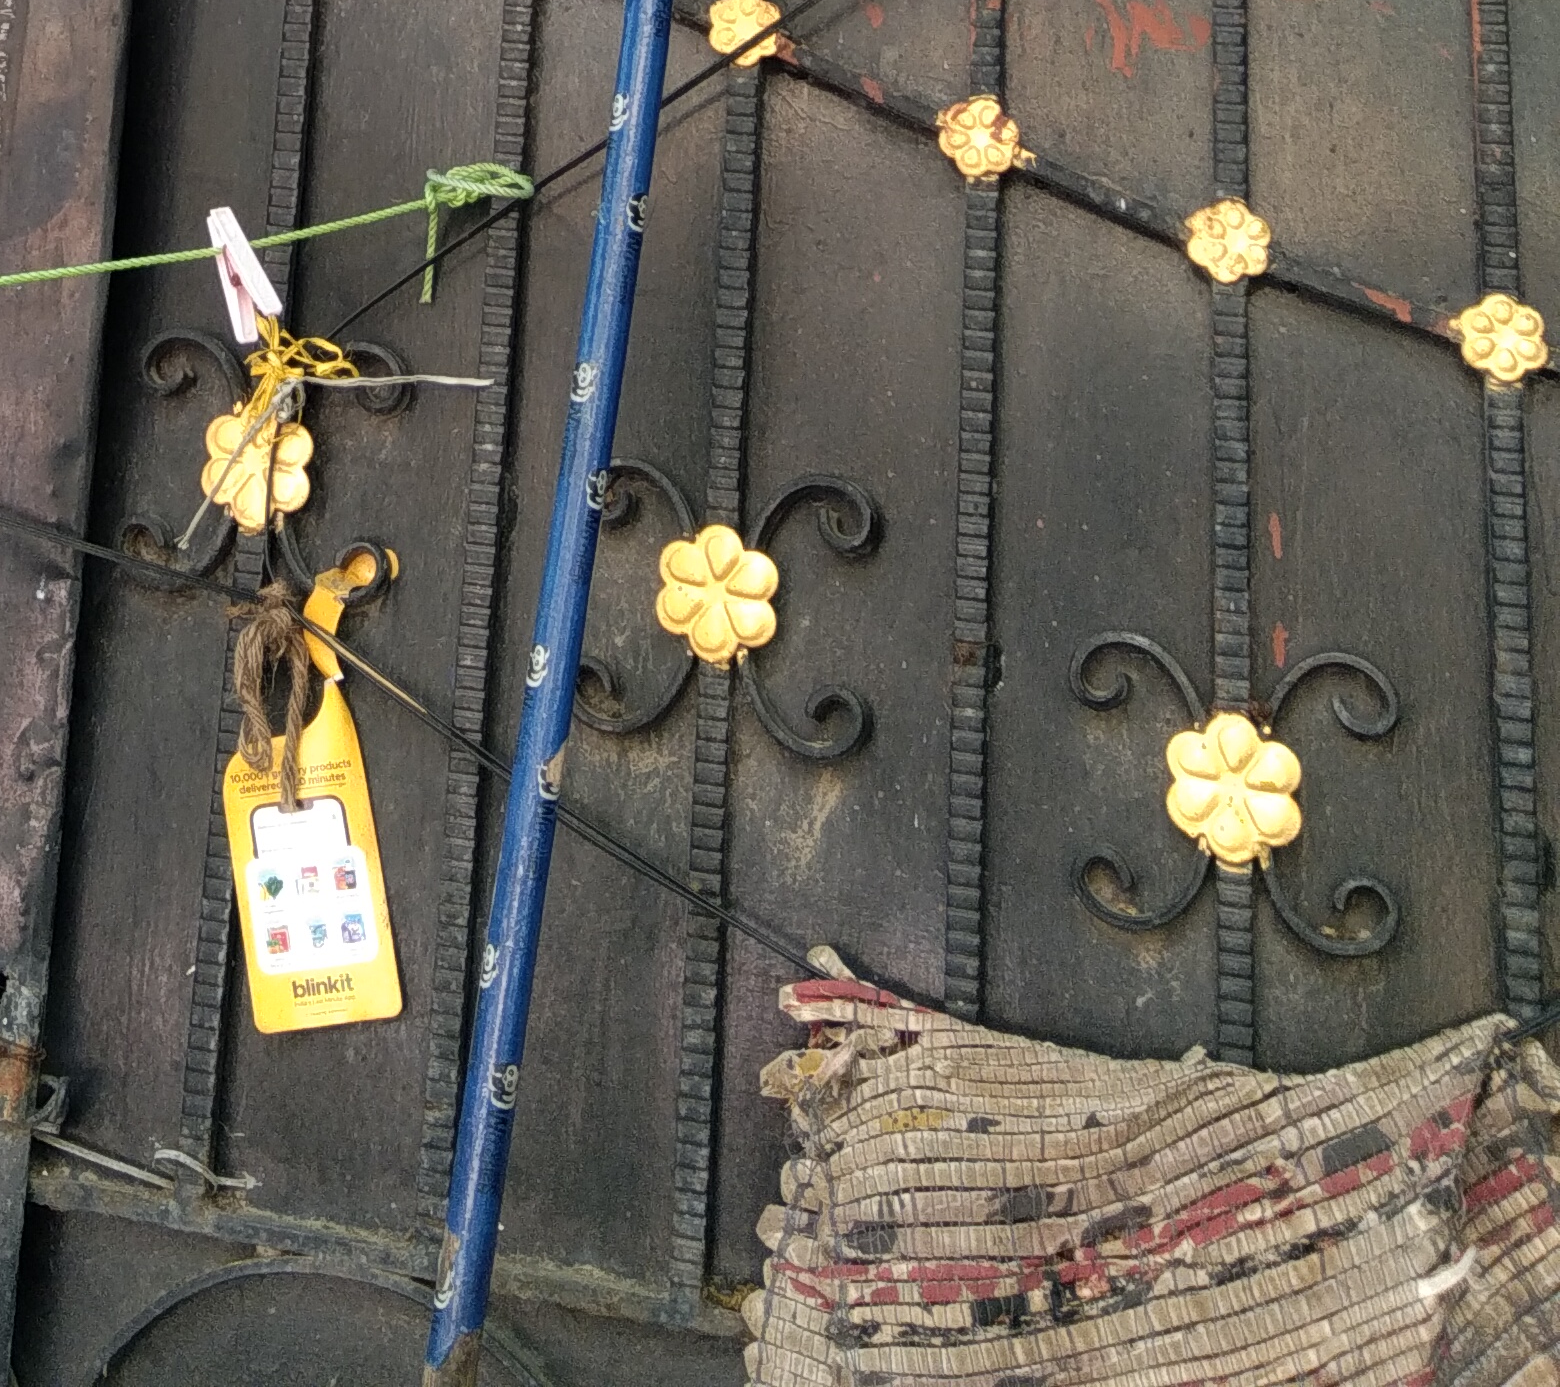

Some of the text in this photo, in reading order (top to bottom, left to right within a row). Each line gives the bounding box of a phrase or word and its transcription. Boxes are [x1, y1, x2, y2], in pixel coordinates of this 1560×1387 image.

[309, 759, 352, 773] products
[308, 771, 346, 785] minutes
[291, 973, 355, 1000] blinkit
